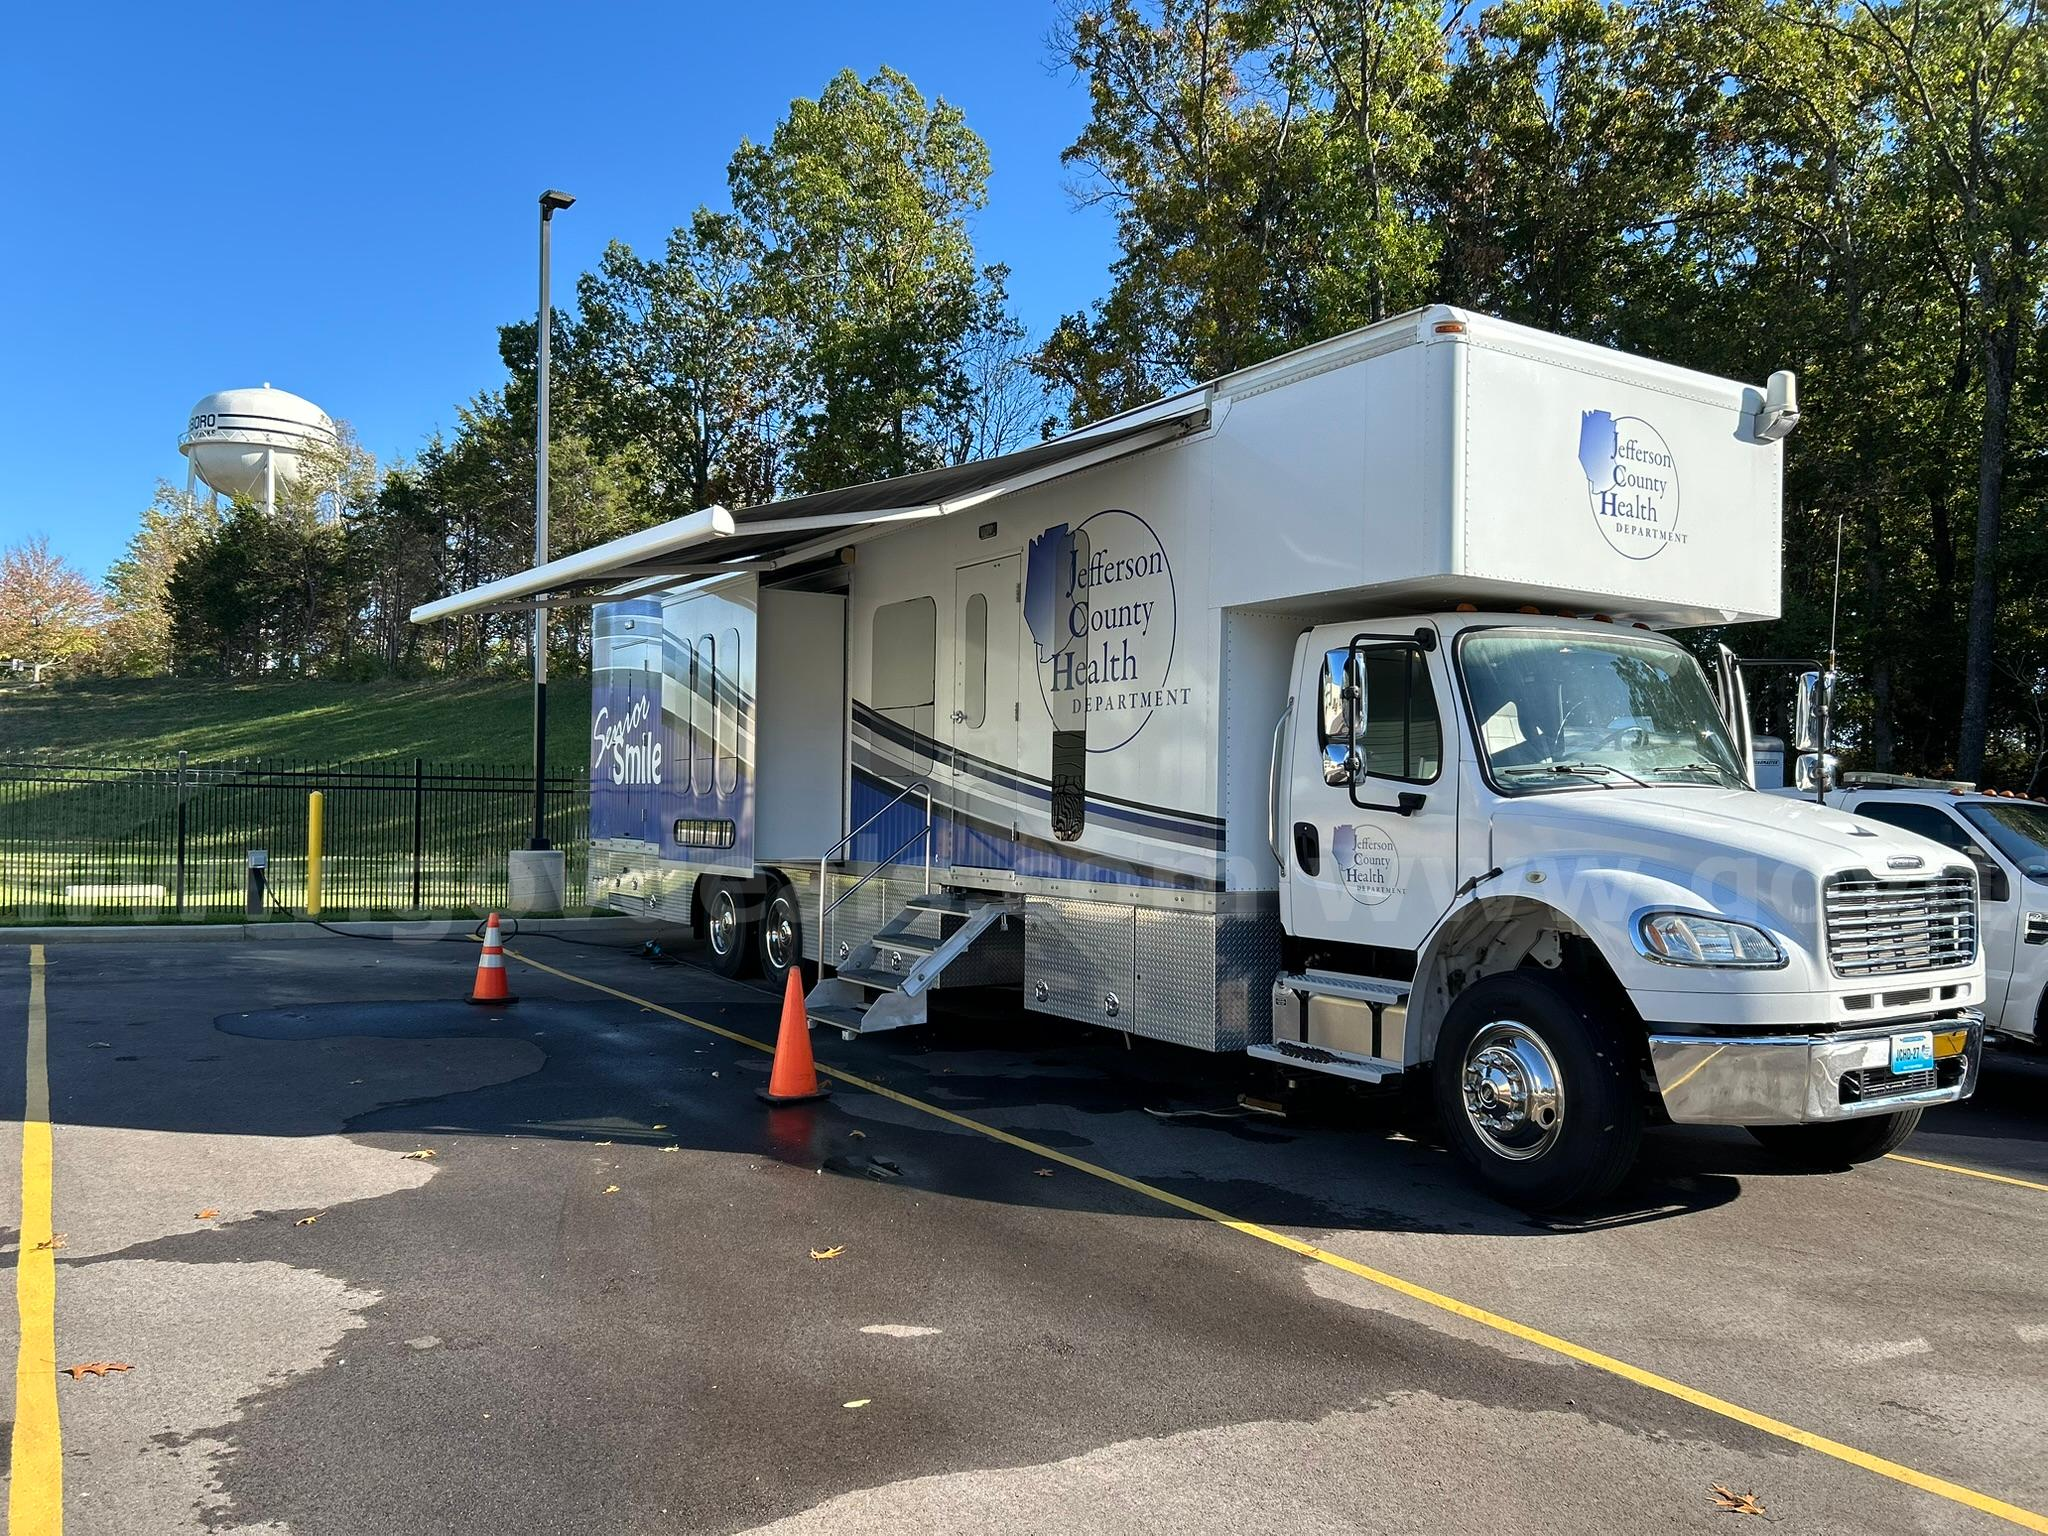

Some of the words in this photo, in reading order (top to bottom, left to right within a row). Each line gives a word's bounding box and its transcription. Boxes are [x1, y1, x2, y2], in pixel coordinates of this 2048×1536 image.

[1610, 431, 1672, 468] Jefferson
[1613, 464, 1667, 499] County
[1600, 490, 1658, 522] Health
[1616, 522, 1688, 544] DEPARTMENT
[1066, 549, 1163, 598] Jefferson
[1069, 600, 1154, 638] County
[1051, 638, 1138, 692] Health
[1072, 687, 1192, 714] DEPARTMENT
[594, 695, 651, 768] Senior
[612, 732, 662, 785] Smile
[1352, 834, 1394, 851] Jefferson
[1346, 868, 1385, 883] Health
[1354, 852, 1391, 869] County
[1357, 885, 1408, 895] DEPARTMENT
